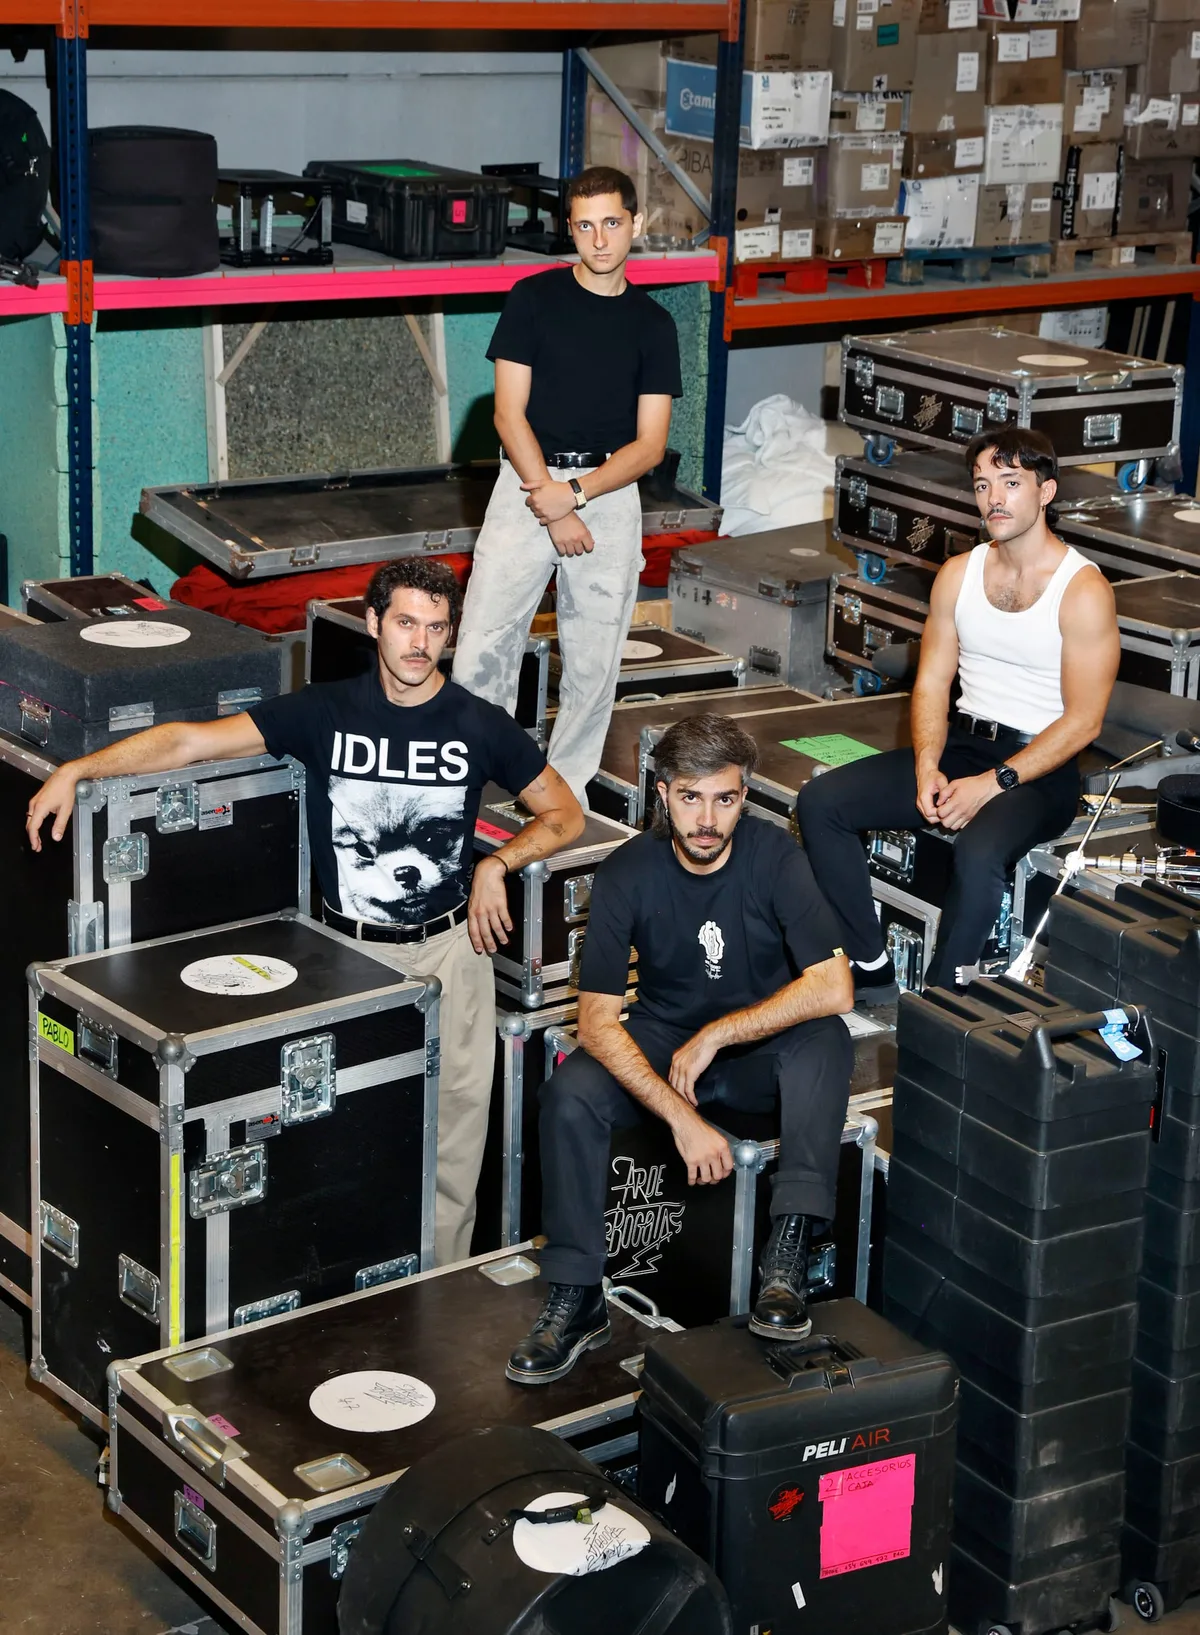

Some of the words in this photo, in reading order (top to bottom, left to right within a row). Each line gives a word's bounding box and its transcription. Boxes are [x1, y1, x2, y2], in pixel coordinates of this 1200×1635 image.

[331, 731, 469, 781] IDLES
[42, 1017, 70, 1048] PABLO
[802, 1438, 846, 1462] PELI
[852, 1428, 891, 1451] AIR
[846, 1459, 912, 1481] ACCESORIOS
[825, 1478, 840, 1492] 2
[847, 1480, 874, 1492] CAJA
